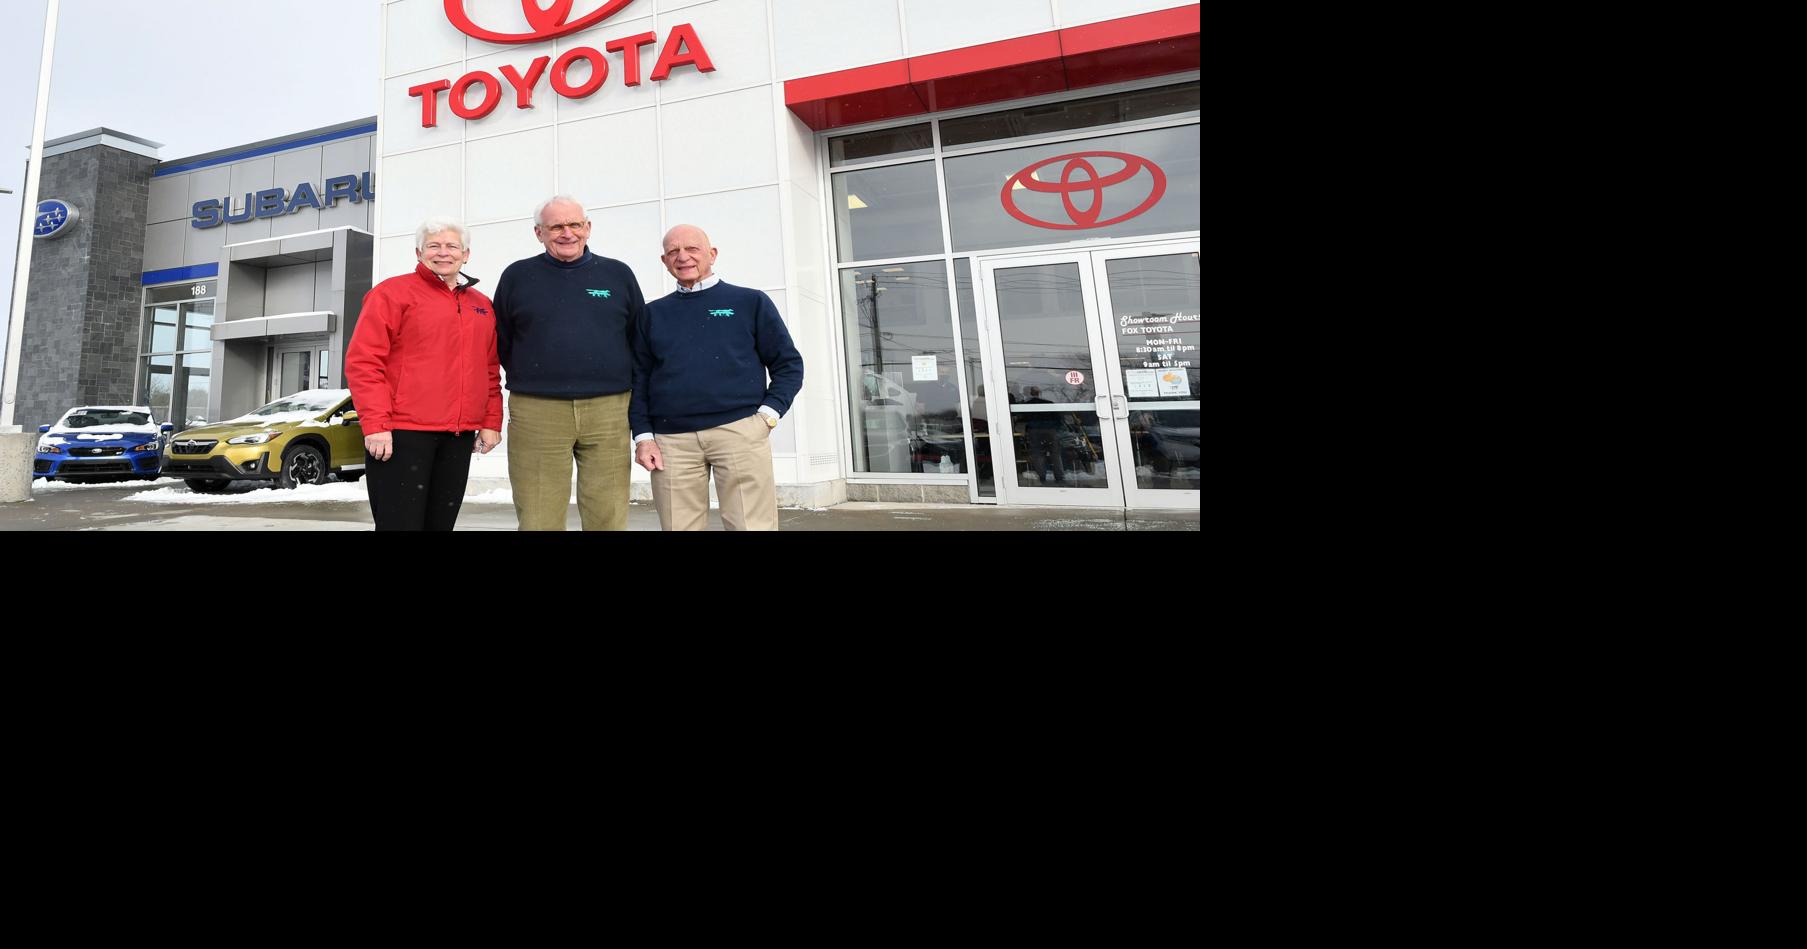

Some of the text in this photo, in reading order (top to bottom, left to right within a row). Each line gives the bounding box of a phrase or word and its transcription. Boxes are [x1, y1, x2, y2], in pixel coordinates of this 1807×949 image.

[409, 23, 716, 128] TOYOTA
[191, 285, 206, 295] 188
[1120, 315, 1168, 327] Showroom
[1122, 325, 1174, 335] FOX TOYOTA
[1146, 338, 1182, 346] MON-FRI
